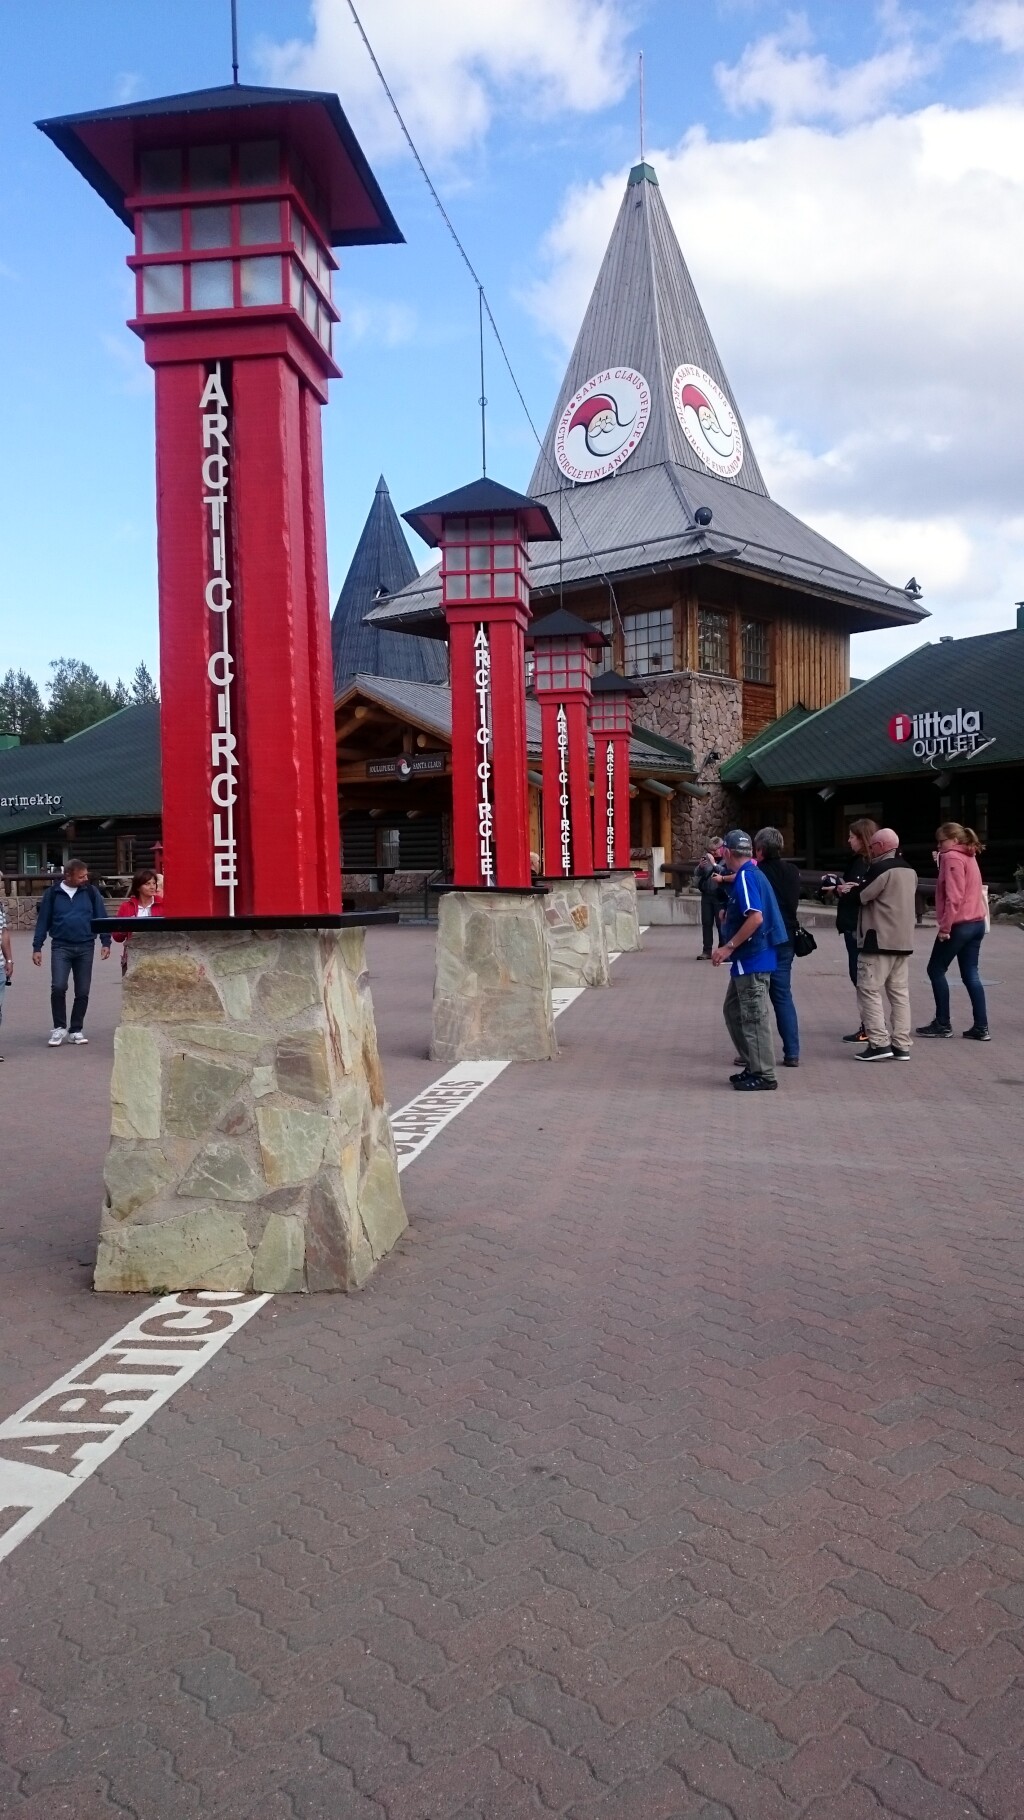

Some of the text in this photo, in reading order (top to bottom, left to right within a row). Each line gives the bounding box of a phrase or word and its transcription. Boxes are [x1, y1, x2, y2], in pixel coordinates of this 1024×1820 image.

[576, 370, 649, 438] SANTA CLAUS OFFICE
[557, 409, 629, 480] ARCTIC CIRCLE FINLAND
[199, 373, 240, 887] ARCTIC CIRCLE
[474, 630, 494, 875] ARCTIC CIRCLE
[912, 707, 981, 739] iittala
[912, 732, 980, 757] OUTLET
[412, 762, 427, 770] SANTA
[427, 760, 442, 769] CLAUS
[556, 707, 571, 869] ARCTIC CIRCLE
[606, 742, 615, 864] ARCTIC CIRCLE
